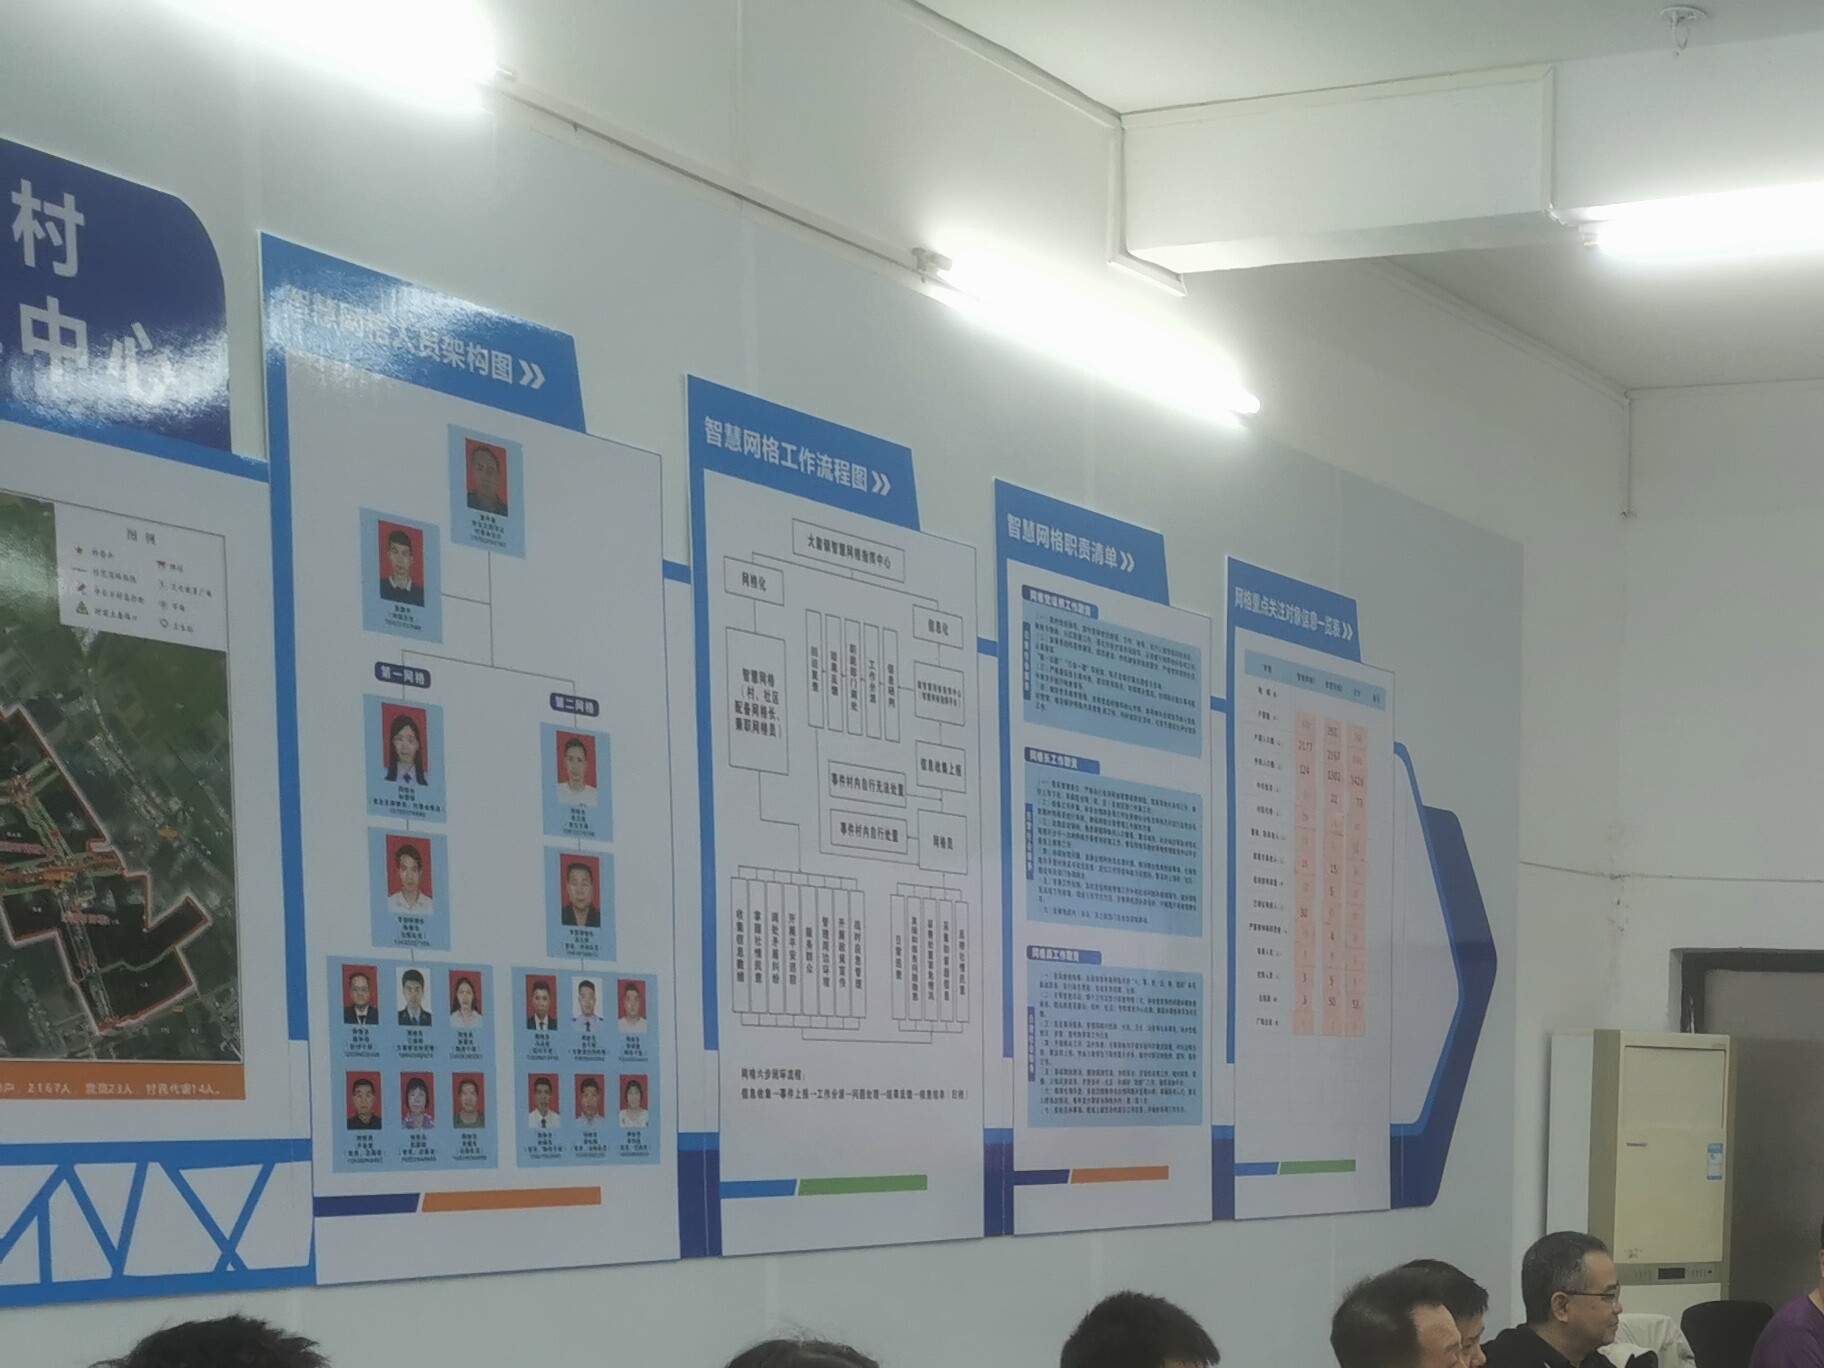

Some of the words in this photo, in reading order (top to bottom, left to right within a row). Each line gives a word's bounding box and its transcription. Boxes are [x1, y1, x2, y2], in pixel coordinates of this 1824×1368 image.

[12, 178, 84, 277] 村
[704, 416, 868, 492] 智慧网格工作流程图
[1007, 513, 1118, 568] 智慧网格职责清单
